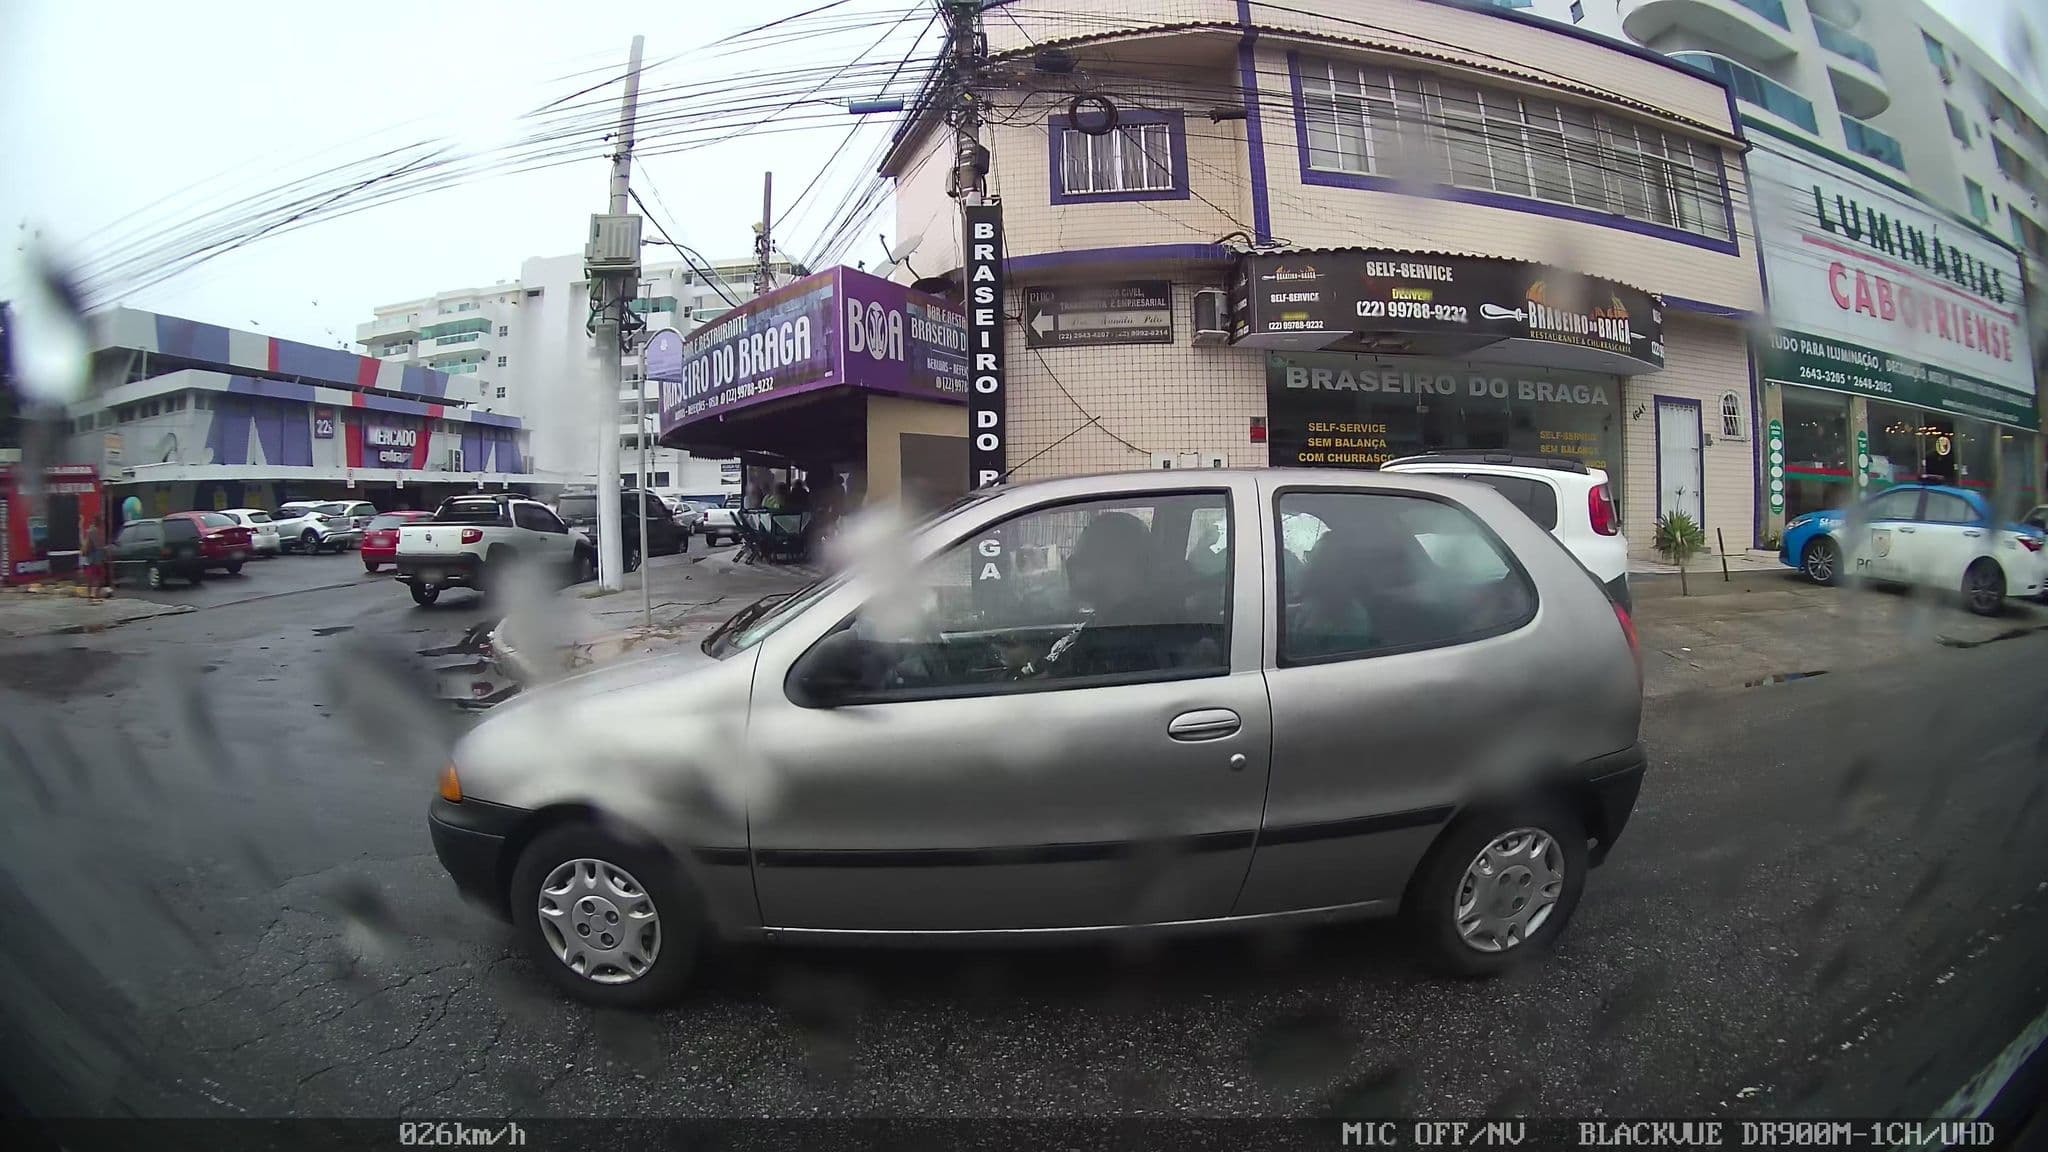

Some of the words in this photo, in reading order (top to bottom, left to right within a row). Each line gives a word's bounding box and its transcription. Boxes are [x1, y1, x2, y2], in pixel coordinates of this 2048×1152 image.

[1813, 185, 2004, 304] LUMINÁRIAS
[1366, 261, 1454, 282] SELF-SERVICE
[973, 222, 999, 393] BRASEIRO
[1270, 293, 1319, 303] SELF-SERVICE
[1357, 300, 1385, 317] (22)
[1388, 302, 1468, 322] 99788-9232
[848, 298, 904, 361] BOA
[911, 317, 958, 350] BRASEIRO
[1598, 317, 1631, 345] BRAGA
[713, 344, 735, 388] DO
[738, 315, 811, 379] BRAGA
[1800, 340, 1826, 358] PARA
[1286, 366, 1456, 396] BRASEIRO
[1469, 377, 1510, 399] DO
[1518, 380, 1609, 406] BRAGA
[977, 410, 999, 452] DO
[1308, 422, 1387, 433] SELF-SERVICE
[1299, 452, 1325, 462] COM
[1308, 437, 1332, 447] SEM
[1335, 438, 1387, 450] BALANÇA
